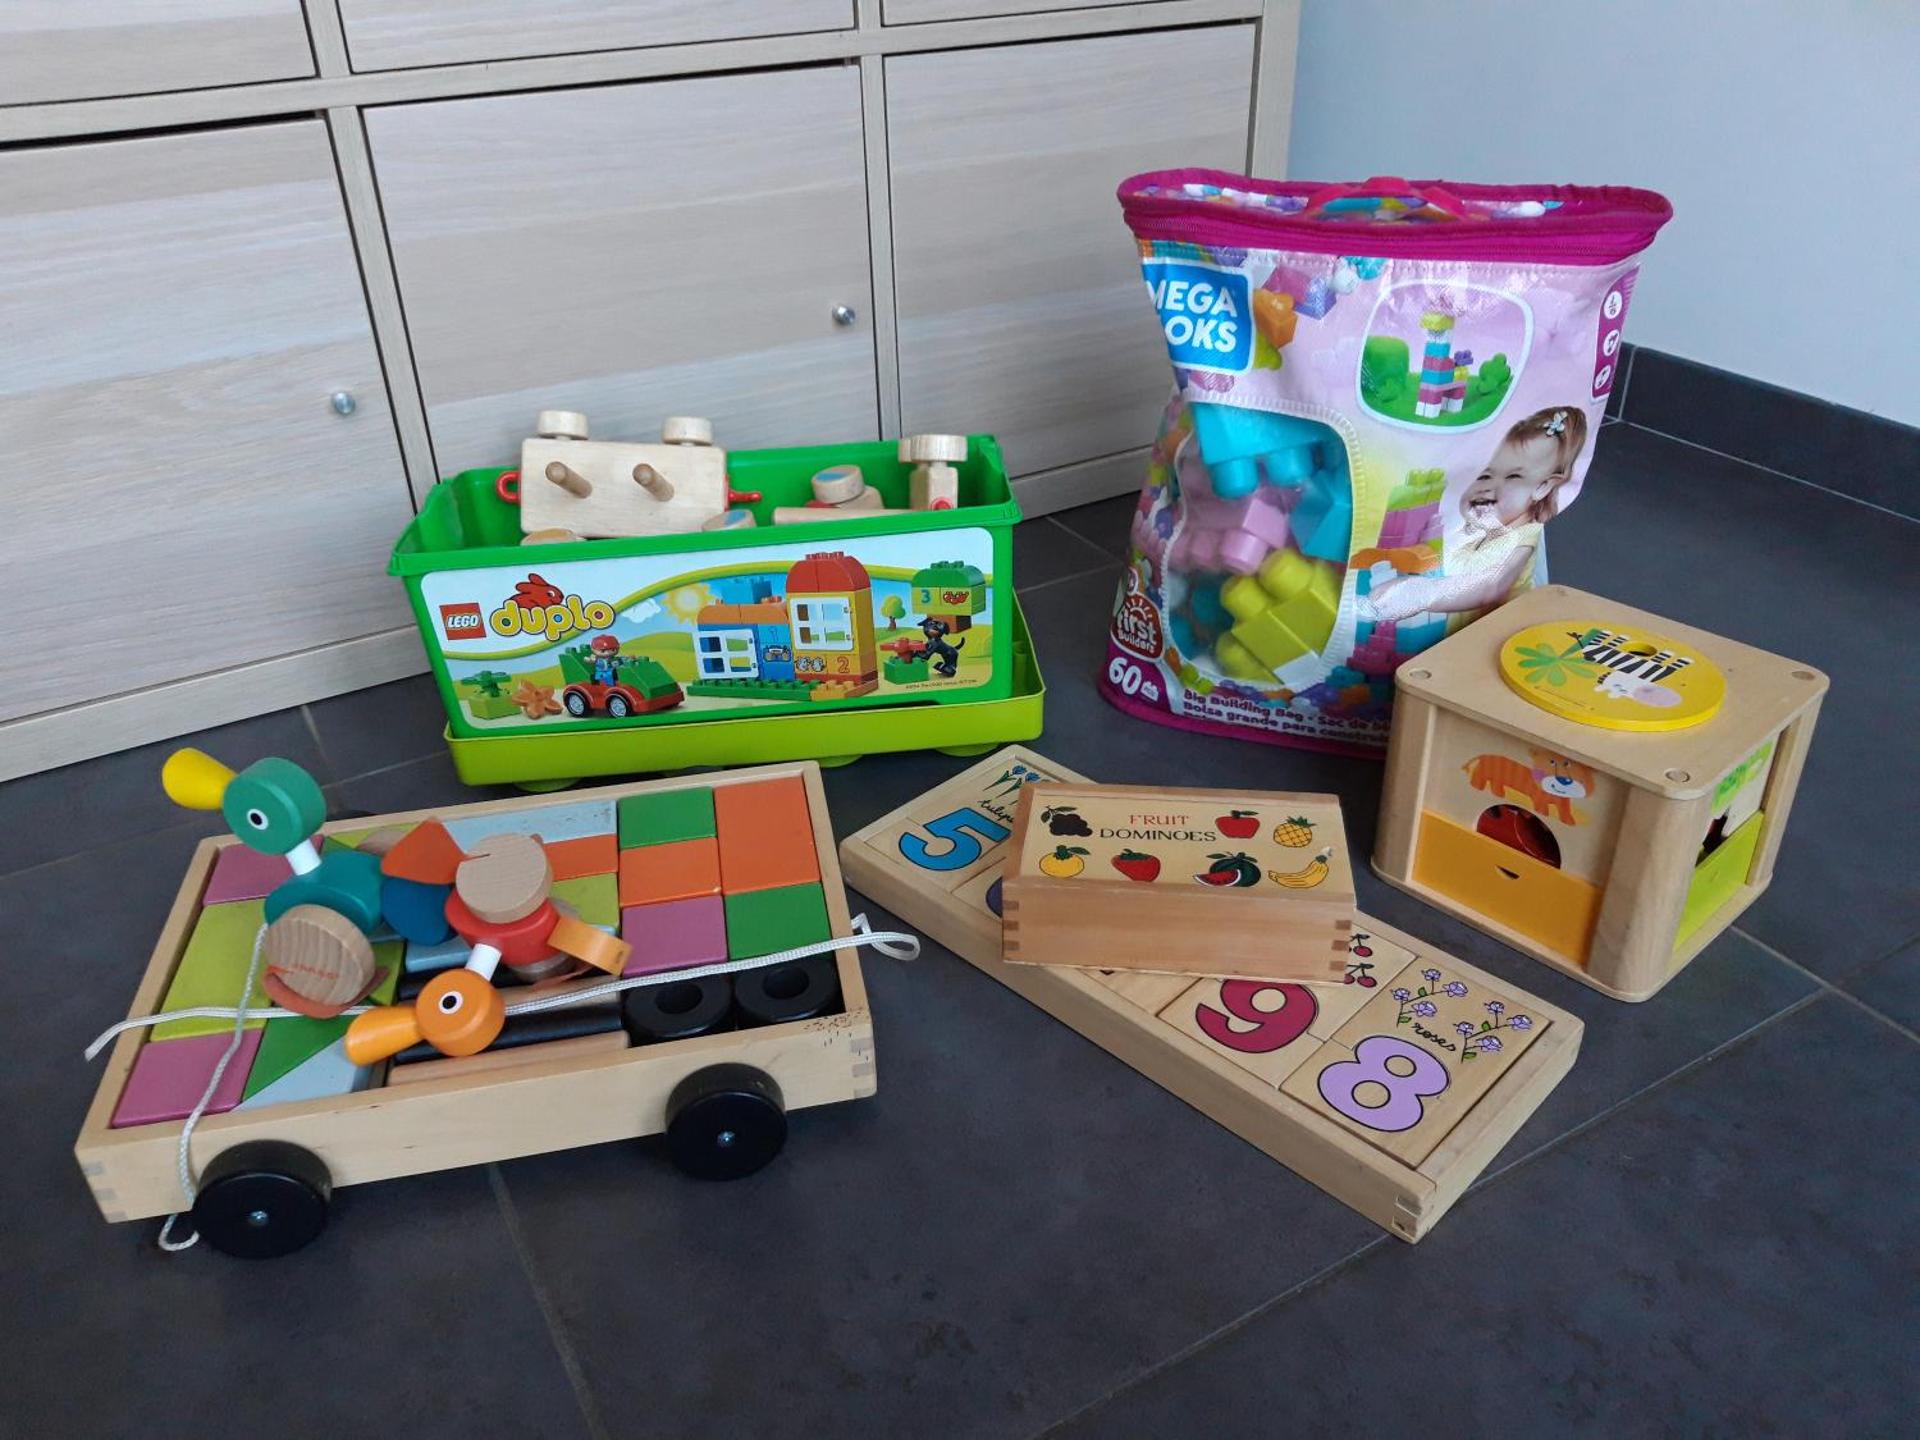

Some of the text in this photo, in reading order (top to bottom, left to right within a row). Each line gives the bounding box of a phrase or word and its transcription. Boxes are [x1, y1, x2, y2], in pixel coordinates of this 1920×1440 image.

[1146, 279, 1238, 318] MEGA
[1164, 315, 1238, 353] OKS
[446, 594, 616, 641] LEGO duplo
[836, 655, 850, 674] 2
[1108, 656, 1142, 696] 60
[1183, 689, 1207, 705] Big
[1210, 695, 1271, 717] Building
[1275, 708, 1304, 723] Bag
[1183, 701, 1223, 718] Bolsa
[1226, 711, 1279, 728] grande
[1099, 828, 1217, 842] DOMINOES
[1129, 814, 1189, 826] FRUIT
[898, 807, 1012, 872] 5
[1195, 977, 1318, 1054] 9
[1411, 1022, 1456, 1052] roses
[1317, 1034, 1451, 1133] 8
